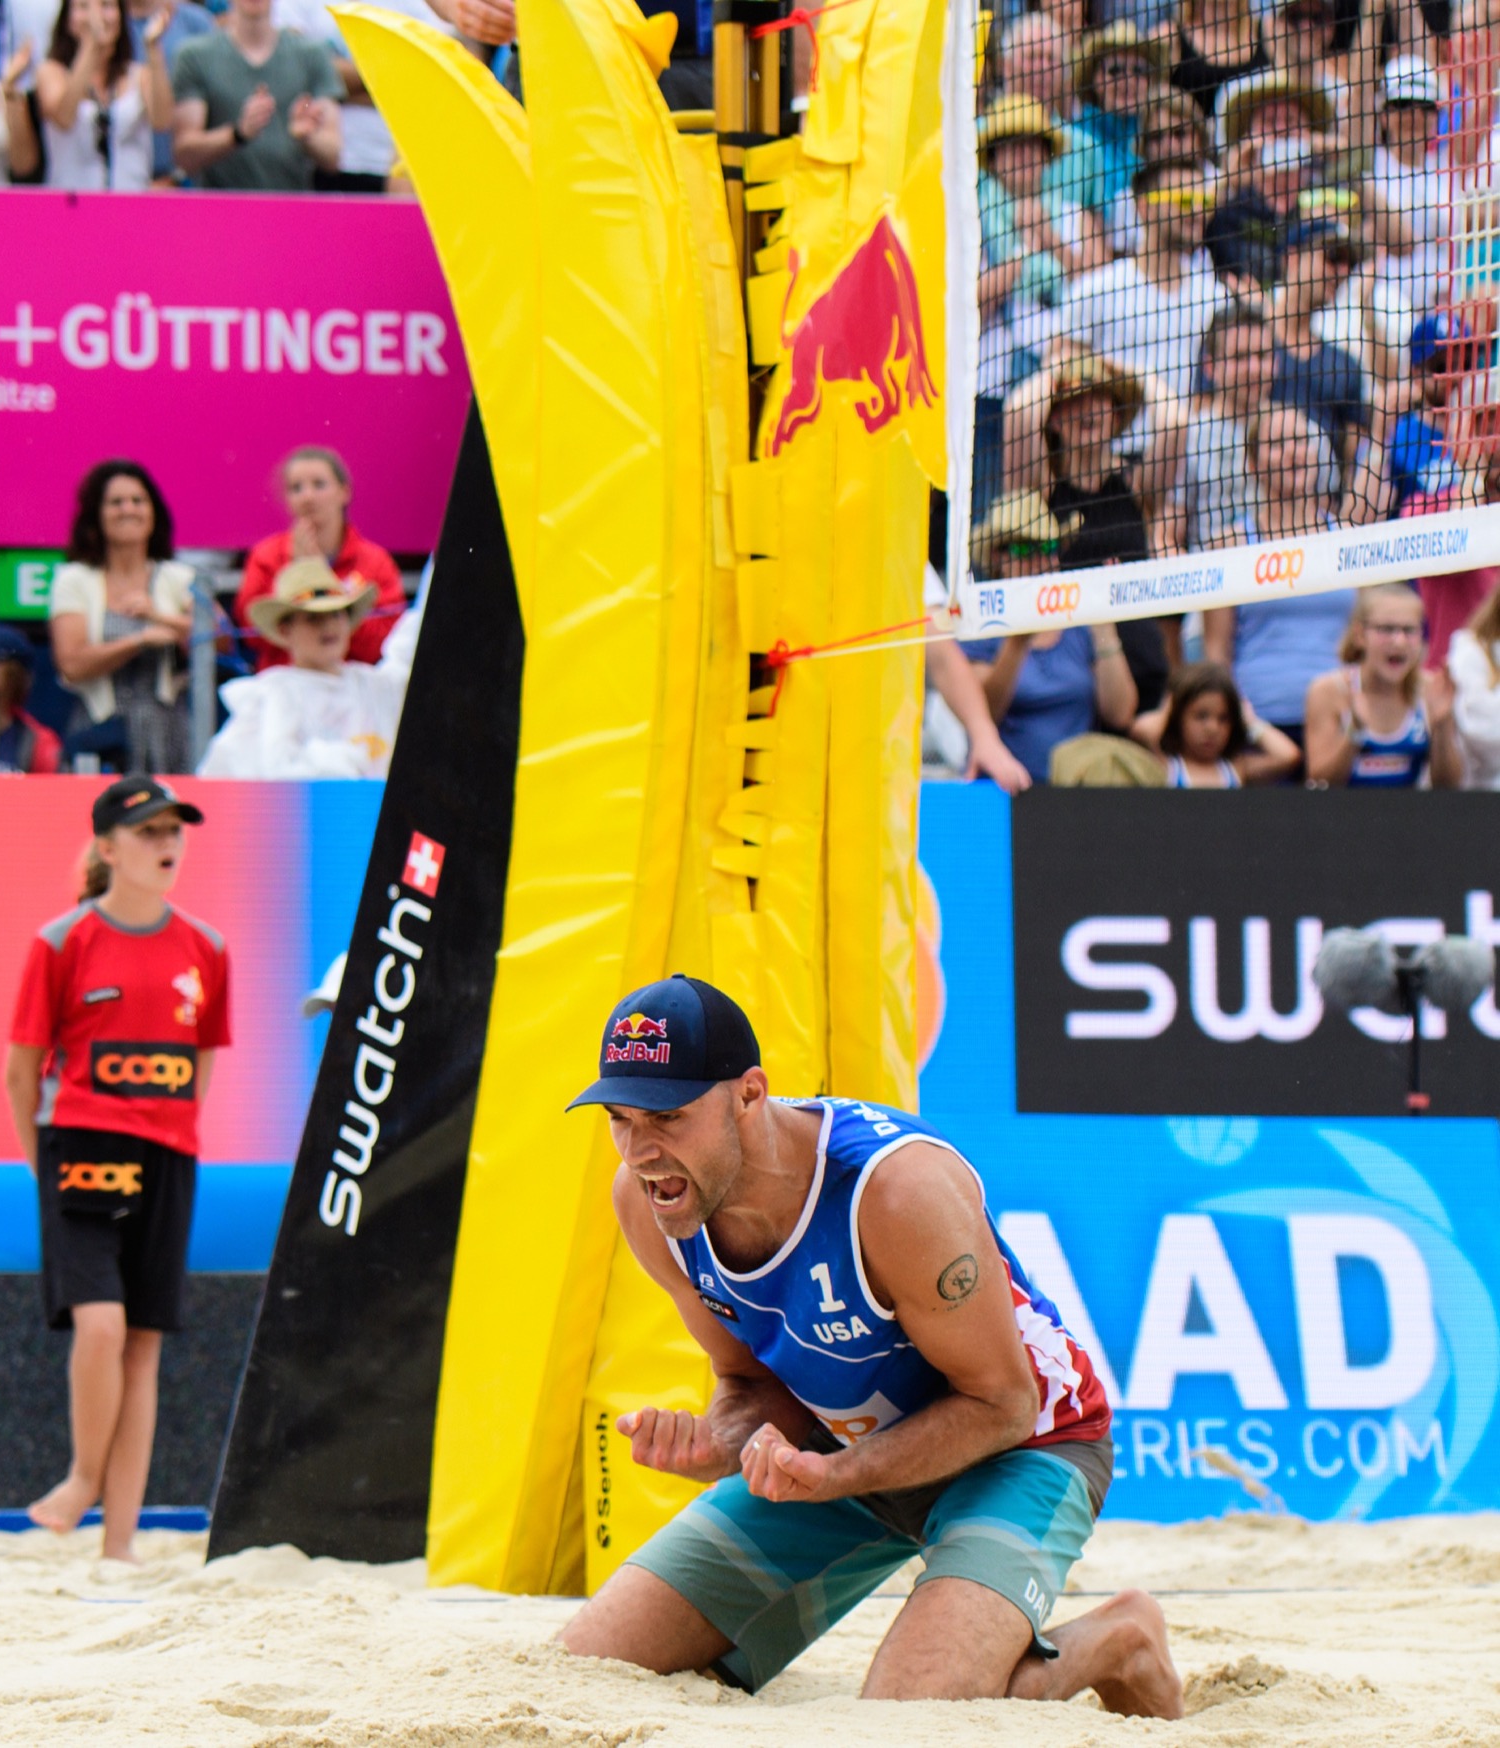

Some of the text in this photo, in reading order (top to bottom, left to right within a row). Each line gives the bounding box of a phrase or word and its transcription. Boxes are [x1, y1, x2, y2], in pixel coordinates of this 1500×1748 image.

[1255, 547, 1305, 590] coop
[1336, 527, 1469, 572] SWATCHMAJORSERIES.COM
[979, 567, 1225, 621] FIVB coop SWATCHMAJORSERIES.COM
[95, 1052, 194, 1094] coop
[319, 897, 432, 1236] swatch
[605, 1041, 671, 1064] Red Bull
[809, 1262, 847, 1313] 1
[812, 1315, 872, 1344] USA
[595, 1412, 611, 1517] Senoh
